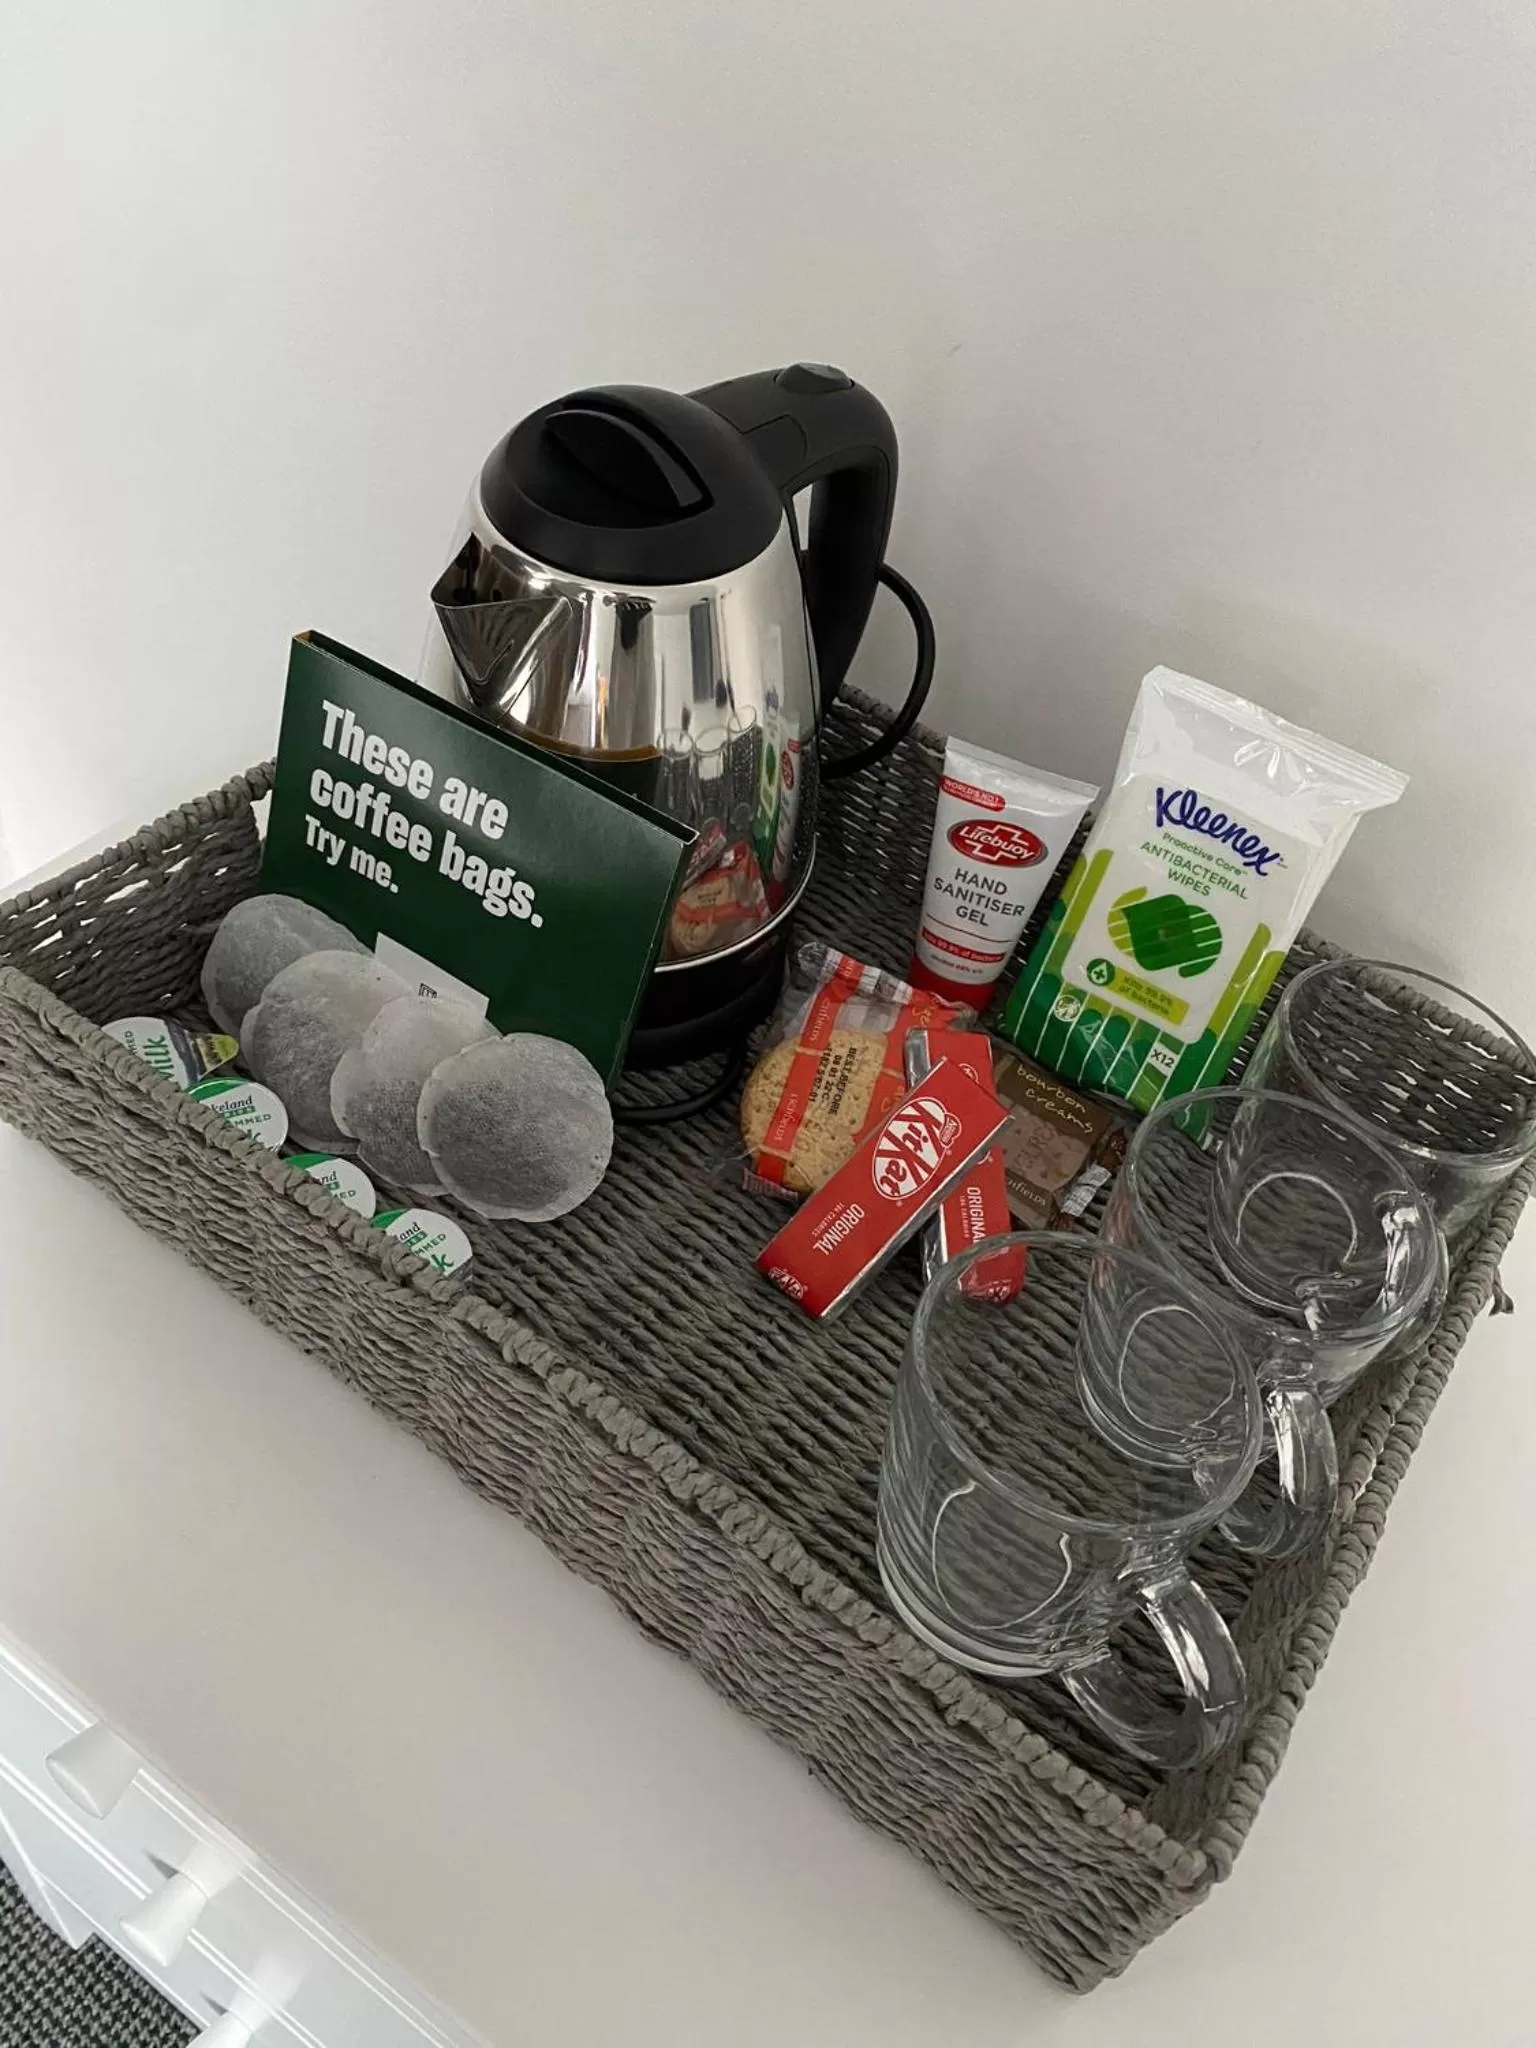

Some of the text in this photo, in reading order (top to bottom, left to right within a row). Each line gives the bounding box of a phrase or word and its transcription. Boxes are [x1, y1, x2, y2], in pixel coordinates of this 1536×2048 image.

[321, 699, 509, 840] These are
[305, 814, 399, 894] Try me.
[310, 768, 544, 928] coffee bags.
[959, 825, 1035, 860] Lifebuoy
[1156, 787, 1280, 876] Kleenex
[1162, 832, 1213, 862] Proactive
[954, 867, 1007, 895] HAND
[1140, 841, 1248, 900] ANTIBACTERIAL
[1168, 868, 1211, 897] WIPES
[934, 877, 1026, 917] SANITISER
[956, 905, 989, 927] GEL
[1017, 1064, 1087, 1114] bourbon
[1025, 1088, 1094, 1134] creams
[813, 1203, 866, 1256] ORIGINAL
